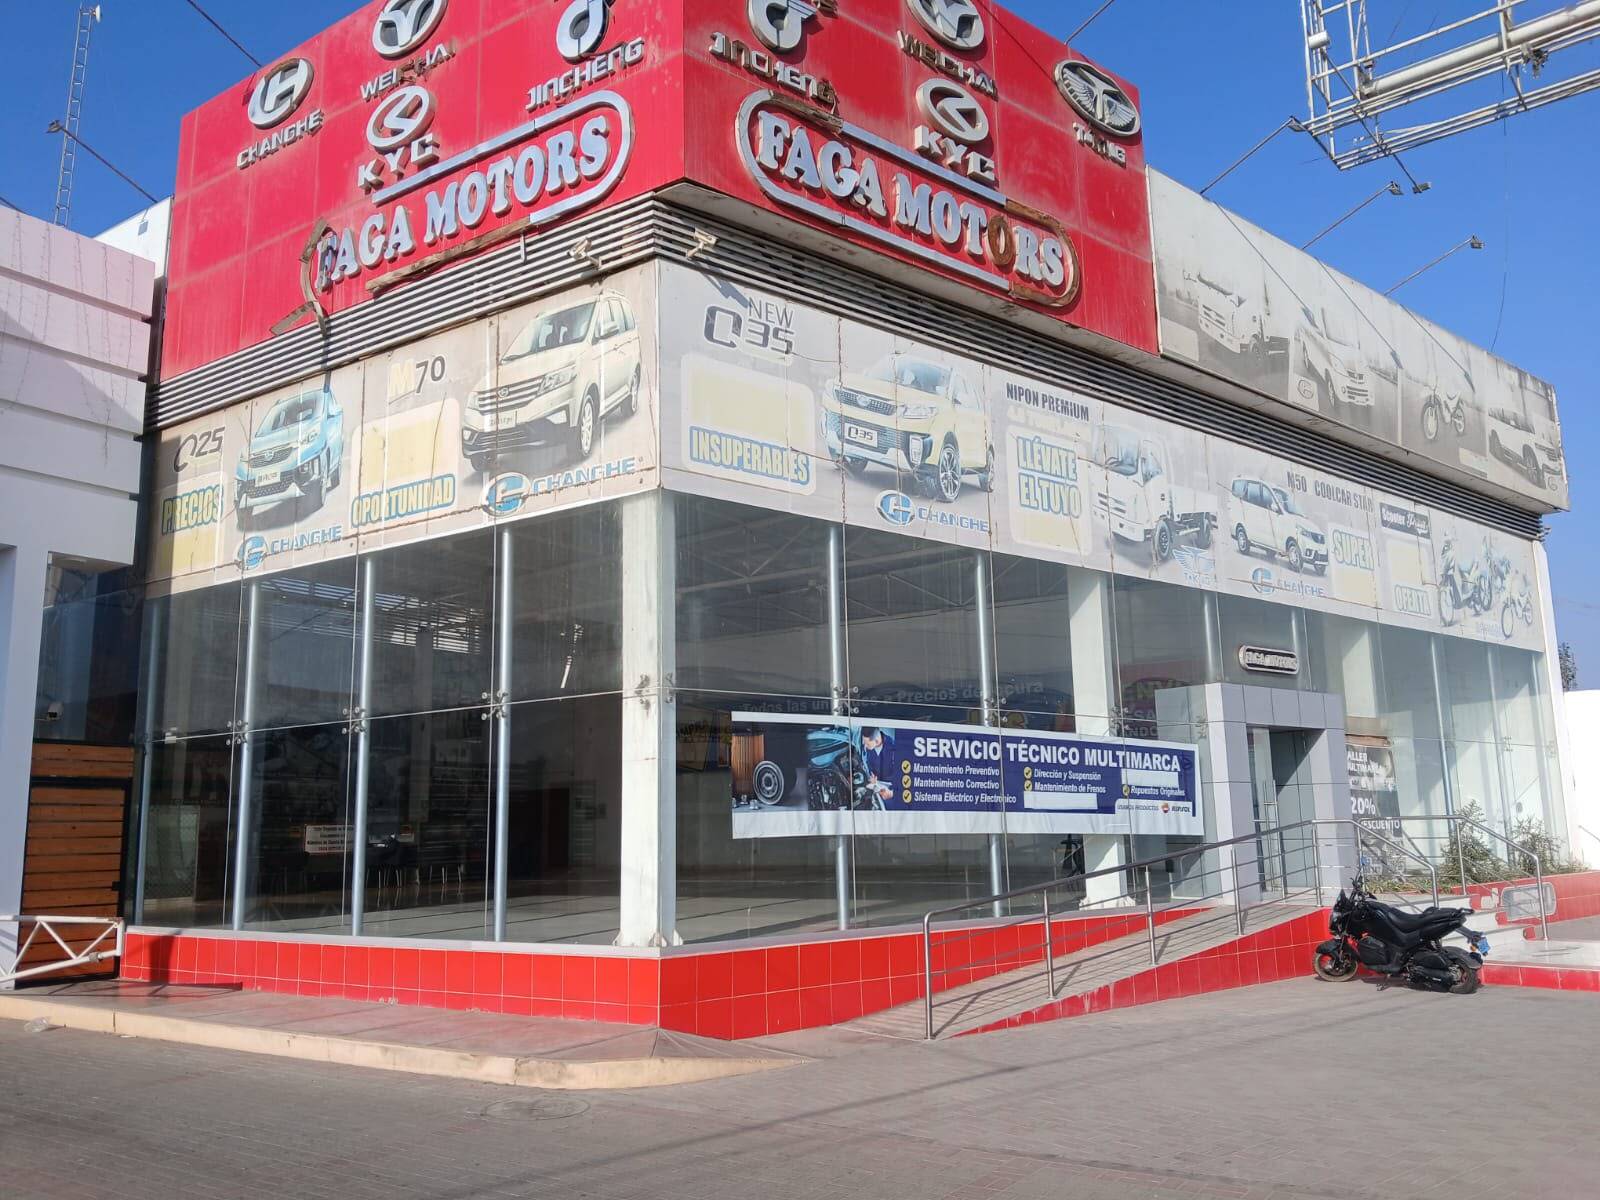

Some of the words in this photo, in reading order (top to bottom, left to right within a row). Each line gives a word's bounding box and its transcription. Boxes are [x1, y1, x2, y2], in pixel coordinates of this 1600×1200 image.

[236, 109, 324, 169] CHANGHE
[315, 204, 416, 291] FAGA
[423, 115, 610, 245] MOTORS
[755, 109, 888, 219] FAGA
[894, 173, 1066, 288] MOTORS
[748, 295, 794, 328] NEW
[703, 304, 796, 356] Q35
[1006, 382, 1039, 408] NIPON
[1041, 393, 1089, 421] PREMIUM
[1018, 472, 1038, 508] EL
[1037, 476, 1083, 519] TUYO
[1314, 480, 1352, 507] COOLCAR
[1353, 490, 1374, 513] STAR
[917, 506, 990, 532] CHANGHE
[269, 525, 342, 557] CHANGHE
[913, 736, 1001, 761] SERVICIO
[1006, 740, 1080, 766] TÉCNICO
[1084, 748, 1181, 772] MULTIMARCA
[913, 763, 964, 776] Mantenimiento
[965, 765, 1000, 777] Preventivo
[913, 777, 964, 789] Mantenimiento
[965, 780, 1000, 790] Correctivo
[1034, 769, 1062, 779] Dirección
[1035, 781, 1077, 793] Mantenimiento
[1078, 783, 1086, 792] de
[914, 791, 942, 802] Sistema
[944, 792, 974, 803] Eléctrico
[974, 795, 980, 805] y
[1350, 796, 1376, 815] 20%
